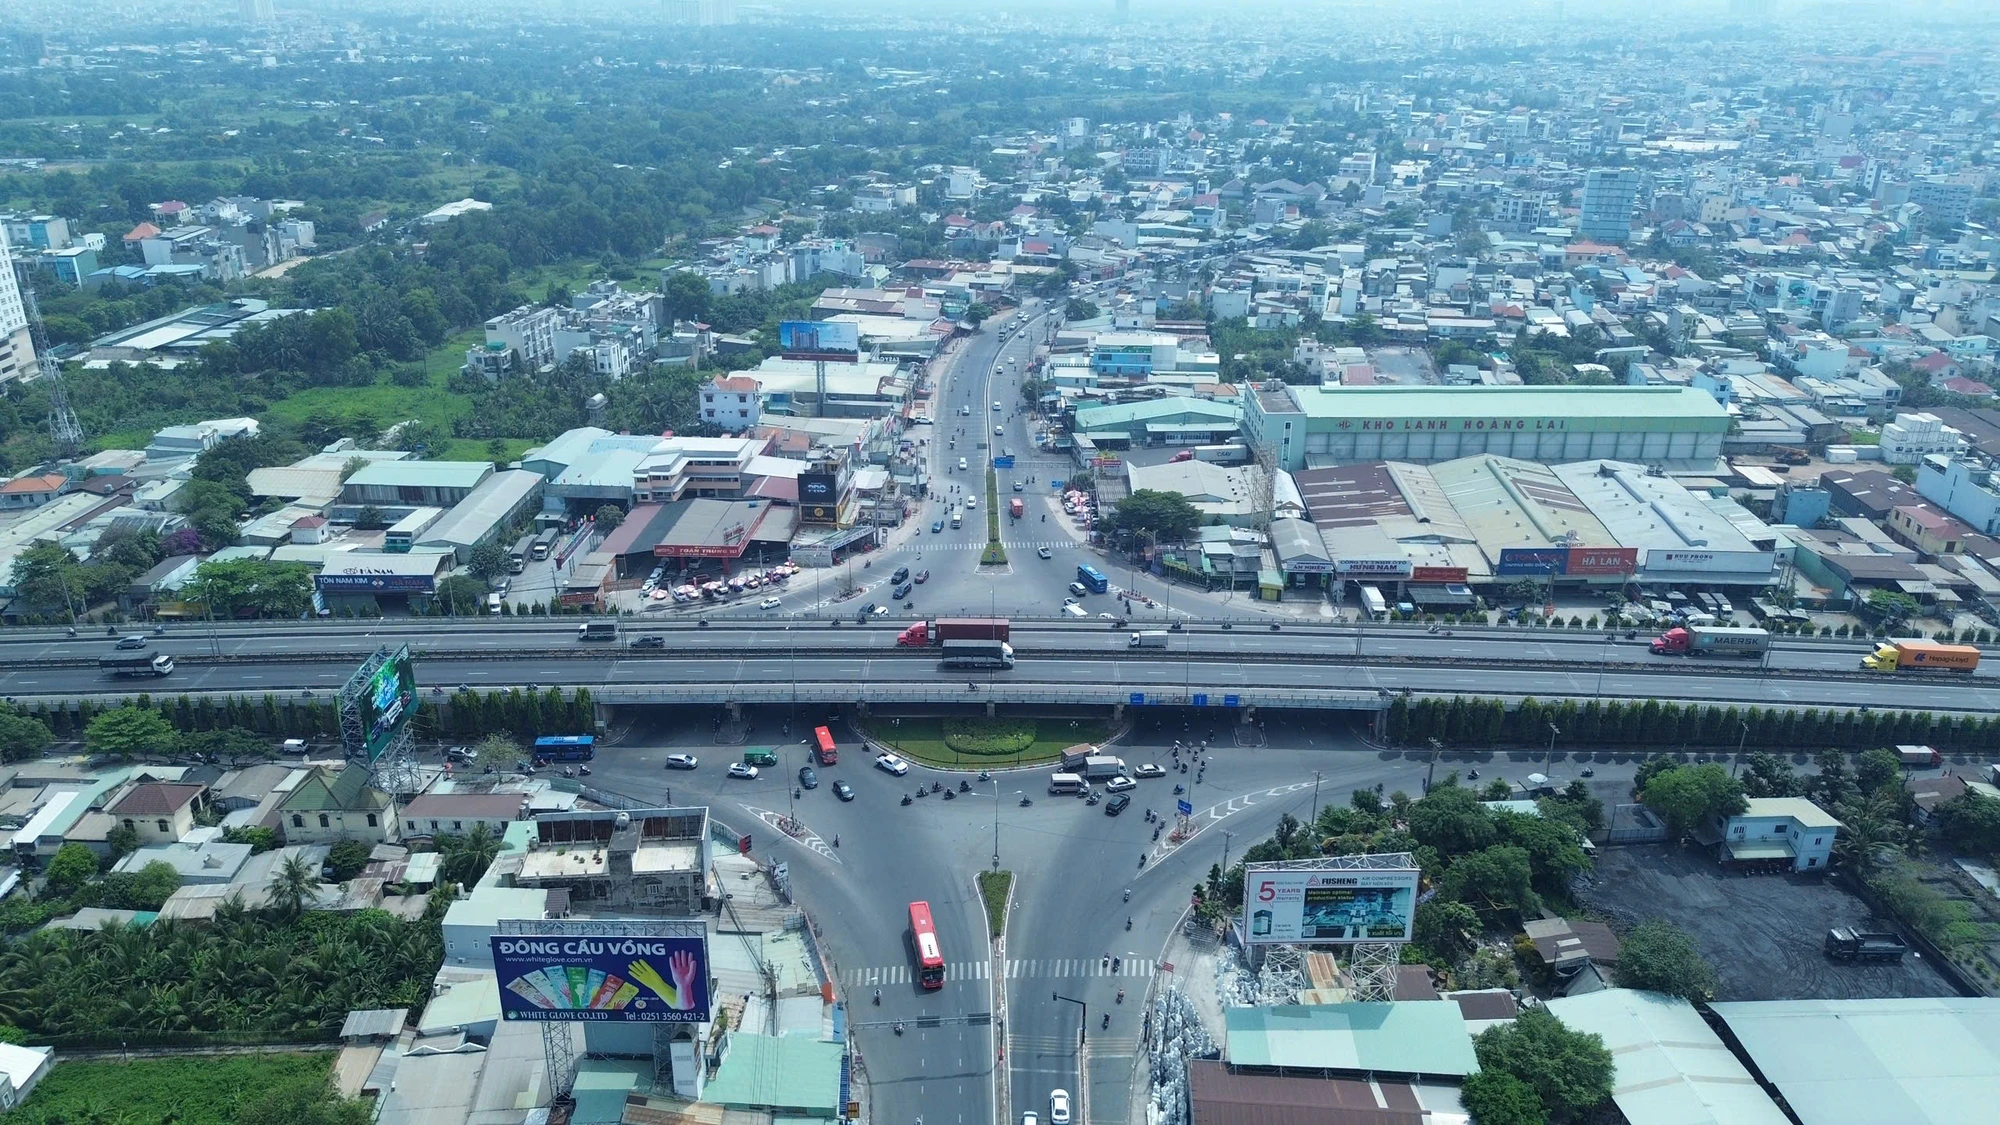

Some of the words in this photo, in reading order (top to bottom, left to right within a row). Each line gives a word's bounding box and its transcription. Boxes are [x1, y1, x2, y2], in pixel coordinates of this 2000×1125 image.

[1362, 420, 1394, 430] KHO
[1404, 420, 1448, 432] LẠNH
[1463, 417, 1525, 430] HOÀNG
[1535, 420, 1565, 430] LAI
[807, 484, 827, 493] PRO
[1581, 555, 1596, 566] HÀ
[1599, 557, 1621, 566] LAN
[318, 576, 335, 584] TÔN
[1714, 637, 1759, 645] MAERSK
[1928, 655, 1970, 664] Hapag-Lloyd
[1321, 877, 1358, 885] FUSHENG
[1258, 881, 1276, 902] 5
[505, 956, 593, 964] www.whiteglove.com.vn
[520, 1011, 548, 1020] WHITE
[549, 1011, 576, 1020] GLOVE
[641, 1012, 660, 1021] 0251
[662, 1012, 682, 1021] 3560
[683, 1012, 705, 1021] 421-2
